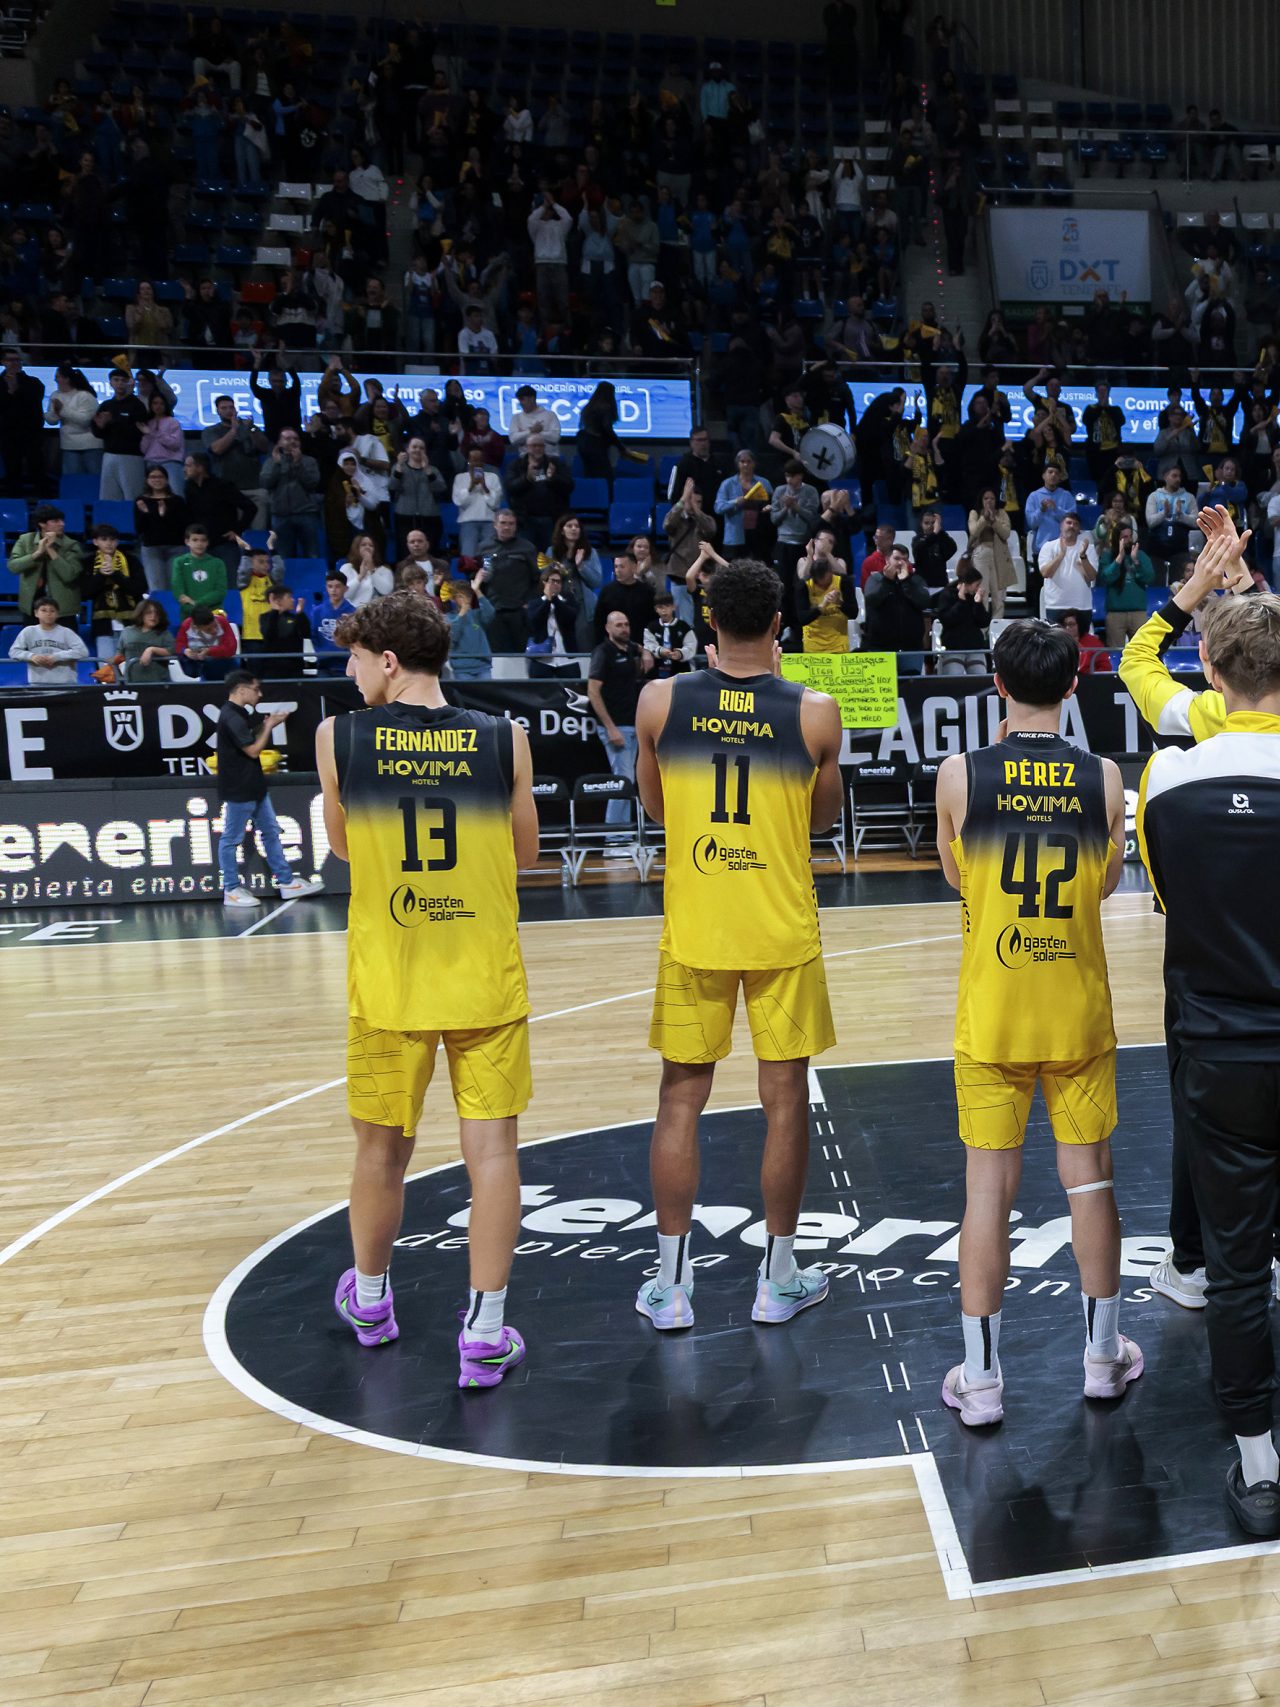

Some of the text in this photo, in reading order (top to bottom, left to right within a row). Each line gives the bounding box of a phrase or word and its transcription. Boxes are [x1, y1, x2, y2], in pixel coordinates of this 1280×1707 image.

[1059, 259, 1120, 282] DXT
[719, 689, 755, 713] RIGA
[692, 716, 774, 738] HOVIMA
[375, 726, 478, 753] FERNÁNDEZ
[720, 736, 745, 744] HOTELS
[377, 759, 472, 777] HOVIMA
[1003, 758, 1077, 787] PÉREZ
[411, 778, 440, 786] HOTELS
[710, 752, 751, 826] 11
[996, 794, 1083, 813] HOVIMA
[397, 796, 458, 873] 13
[719, 844, 757, 862] gasten
[728, 860, 751, 871] solar
[1000, 831, 1079, 919] 42
[418, 895, 465, 912] gasten
[429, 911, 456, 922] solar
[1023, 935, 1067, 953] gasten
[1032, 952, 1059, 962] solar
